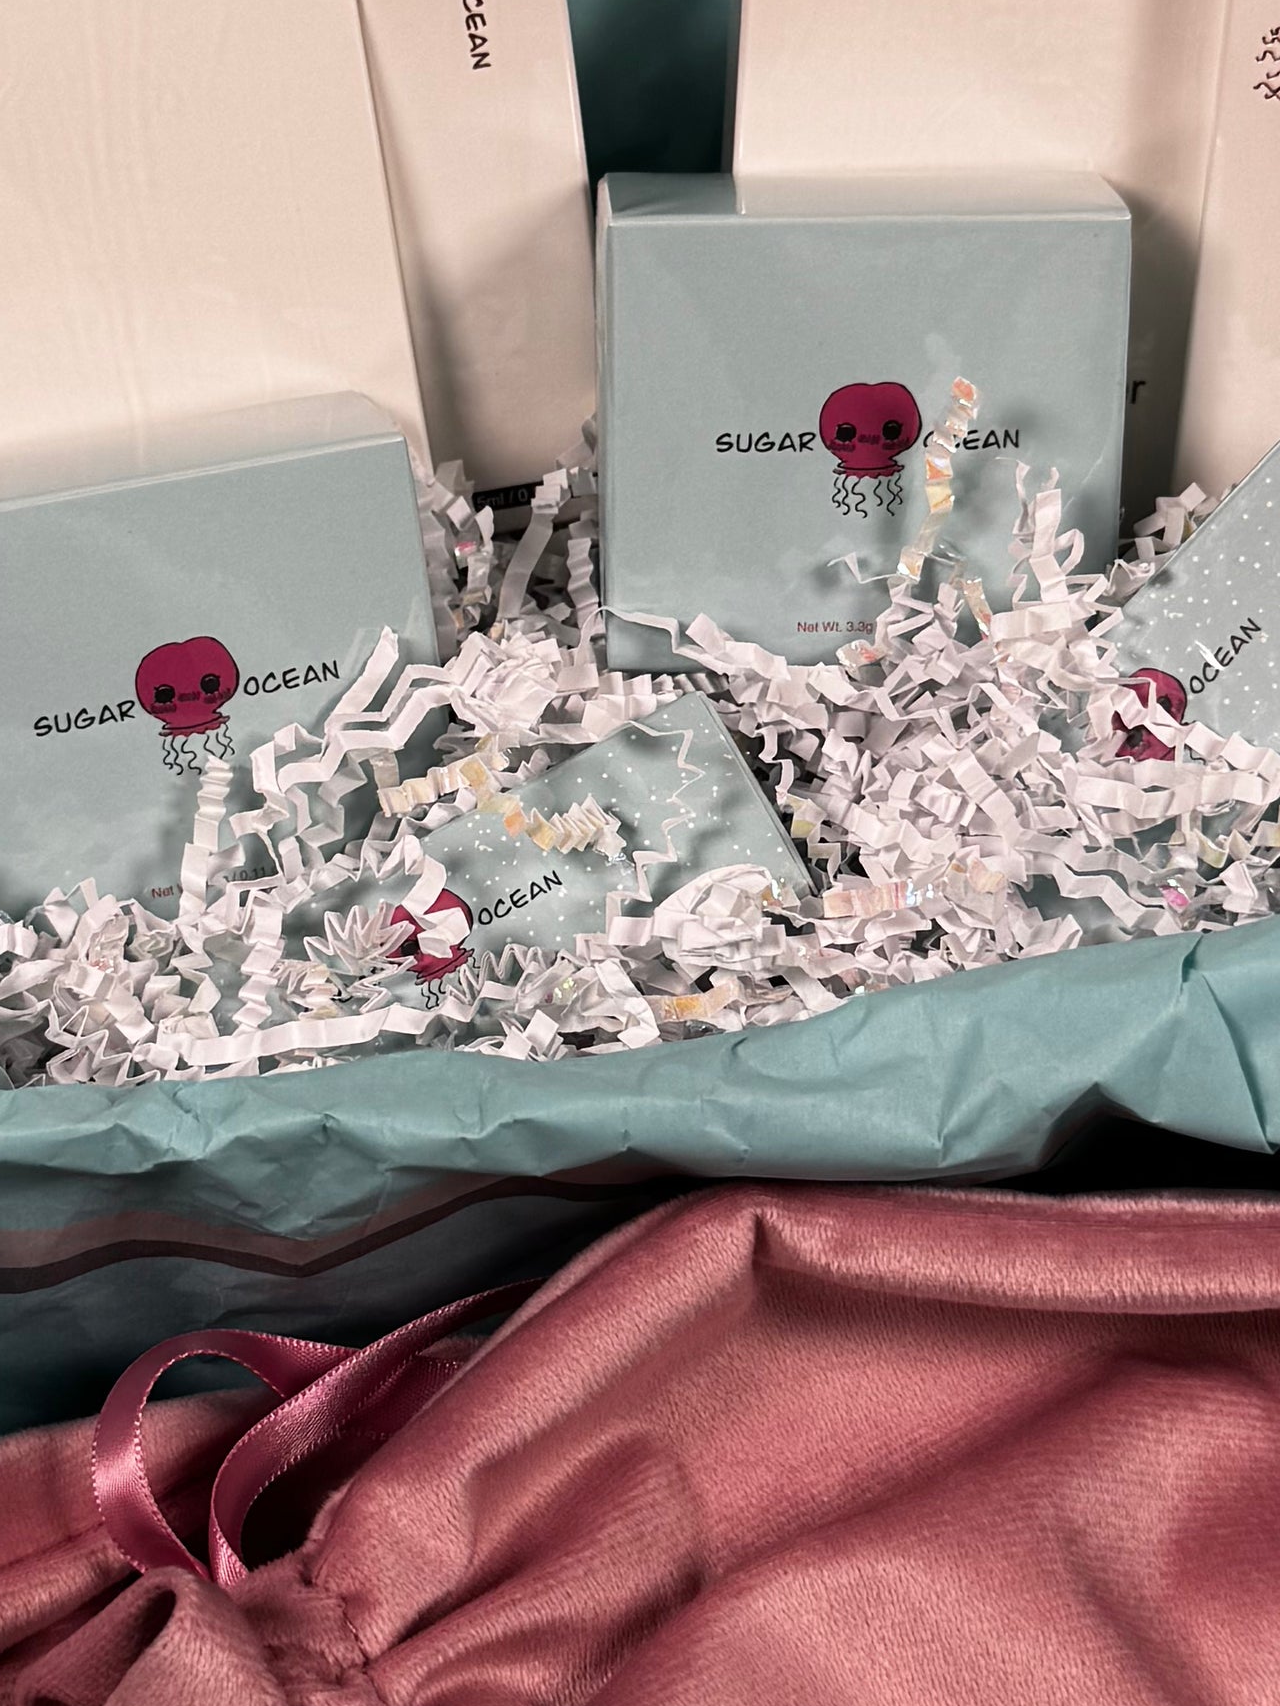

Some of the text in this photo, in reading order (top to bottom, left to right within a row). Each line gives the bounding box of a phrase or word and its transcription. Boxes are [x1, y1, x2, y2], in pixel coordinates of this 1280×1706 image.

[716, 431, 817, 453] SUGAR
[796, 621, 819, 633] Net
[845, 621, 875, 635] 3.3g
[1189, 617, 1262, 694] OCEAN
[33, 659, 341, 736] SUGAR OCEAN
[478, 870, 563, 926] OCEAN
